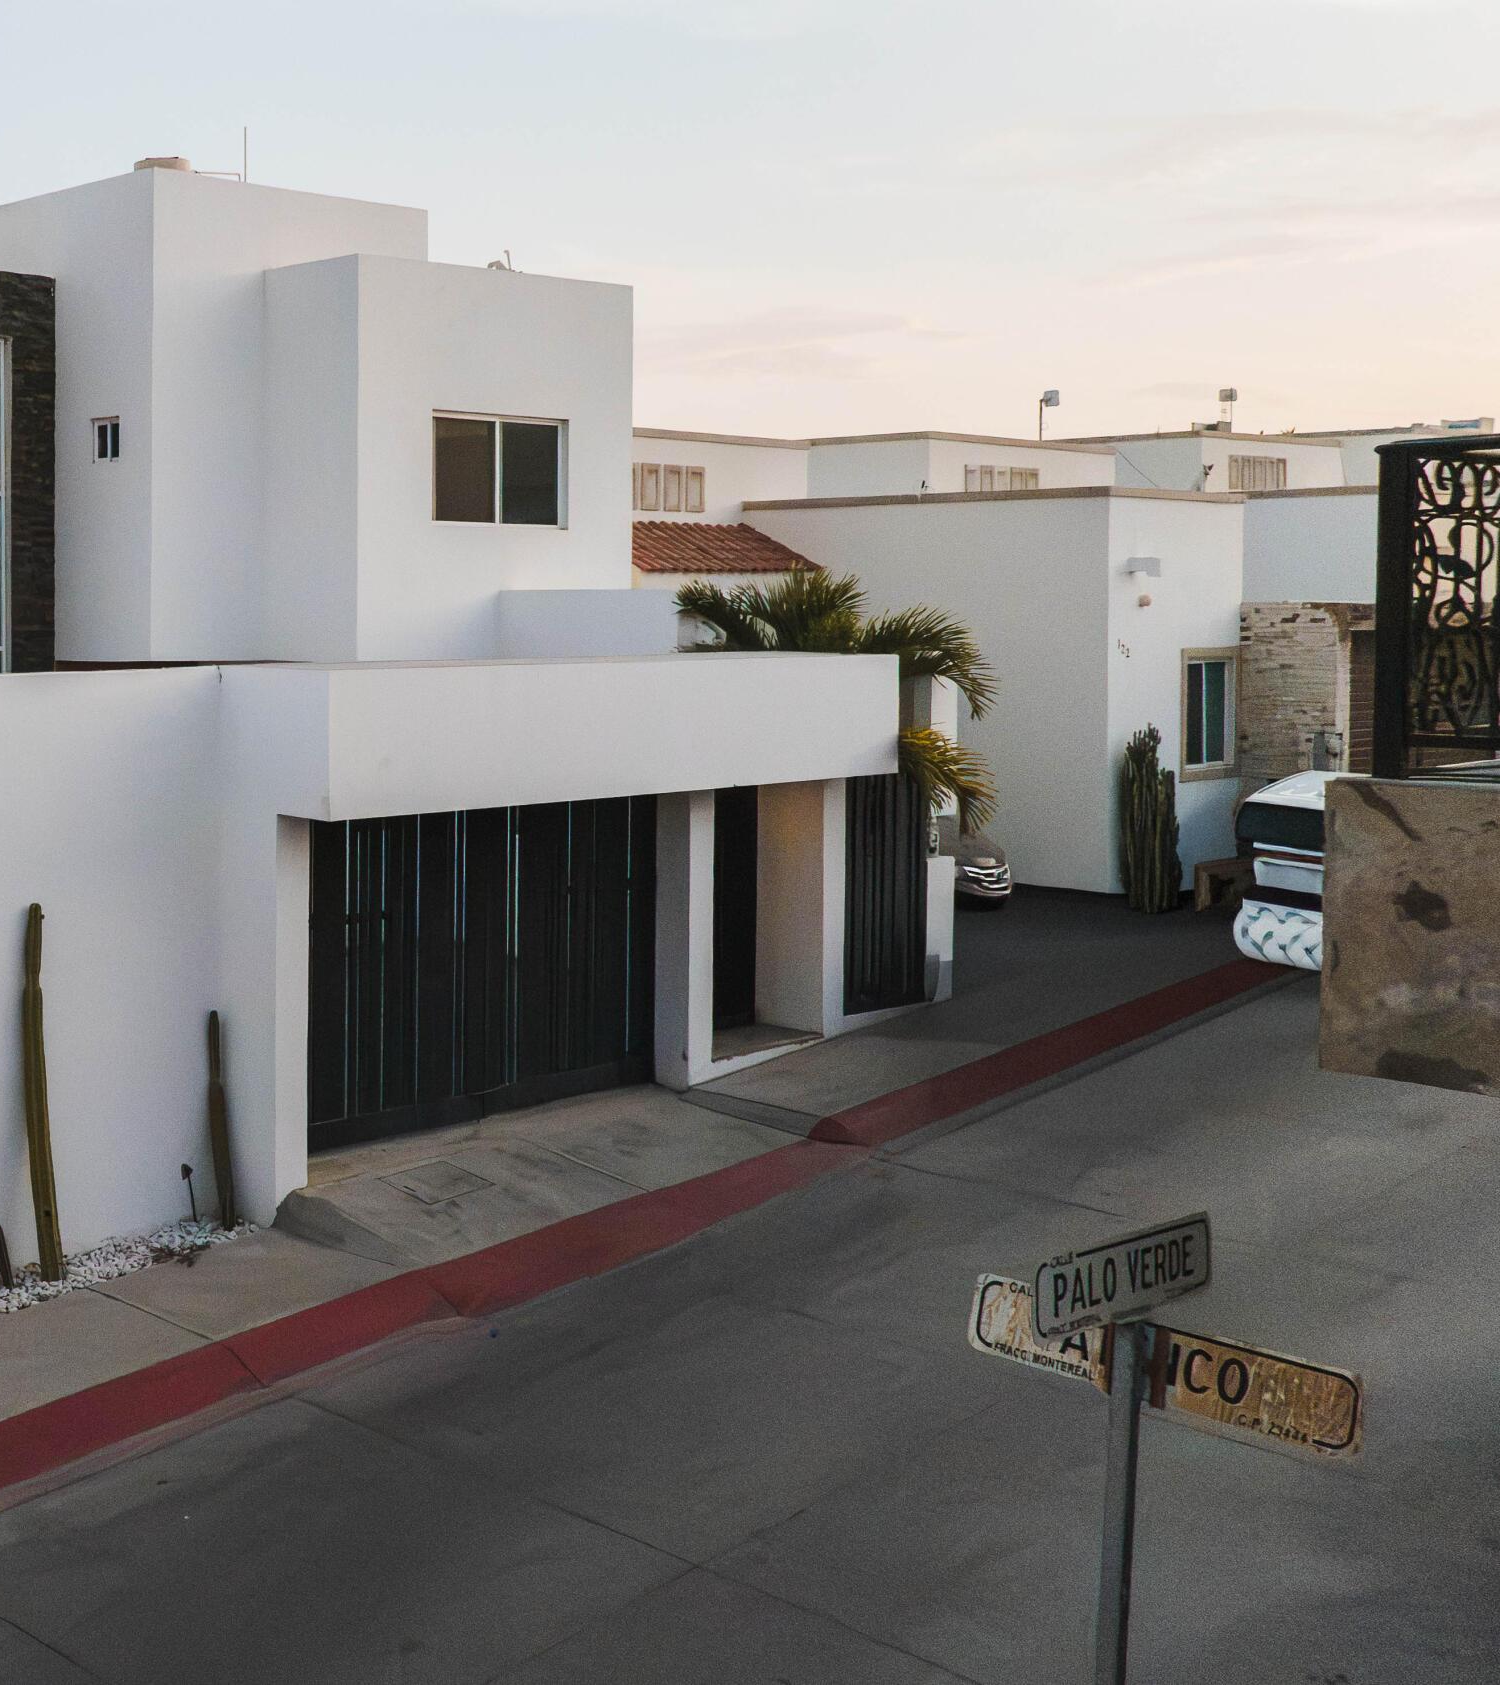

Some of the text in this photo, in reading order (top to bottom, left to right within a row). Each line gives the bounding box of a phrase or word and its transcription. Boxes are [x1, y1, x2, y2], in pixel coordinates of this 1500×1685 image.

[1009, 1281, 1033, 1298] CAL
[1053, 1234, 1195, 1318] PALO VERDE
